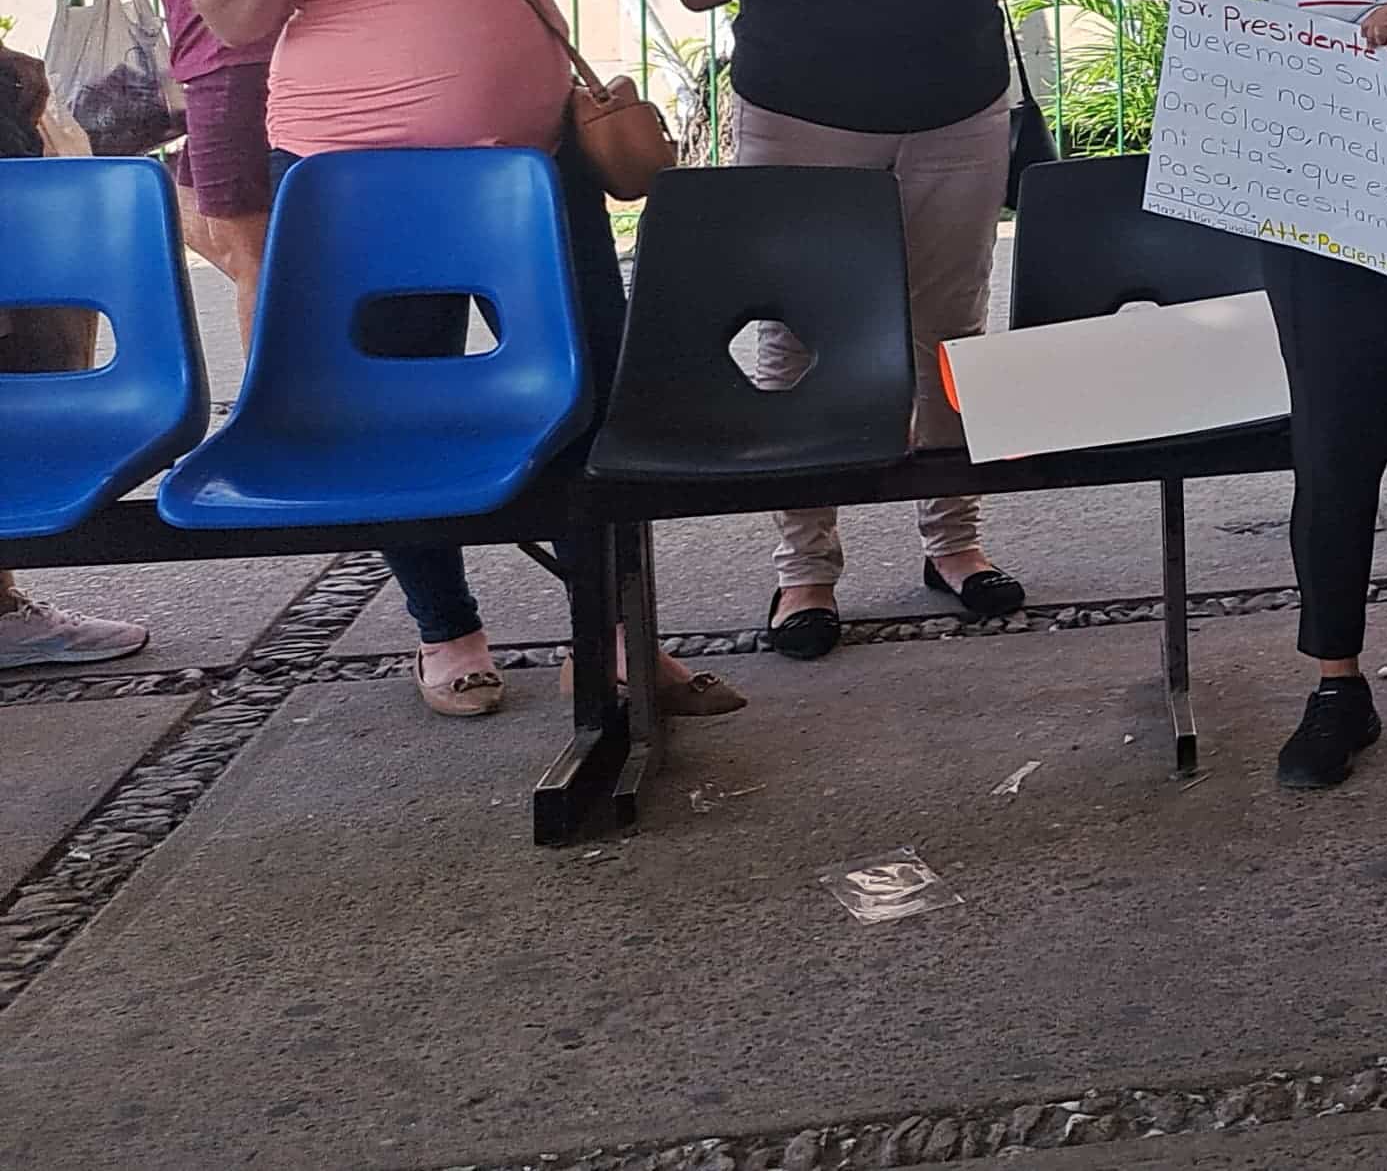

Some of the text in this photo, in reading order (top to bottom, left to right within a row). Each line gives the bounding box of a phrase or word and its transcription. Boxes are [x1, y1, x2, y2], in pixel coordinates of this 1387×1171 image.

[1223, 5, 1380, 62] Presidente
[1277, 87, 1316, 111] no
[1161, 128, 1187, 147] ni
[1301, 162, 1358, 190] que
